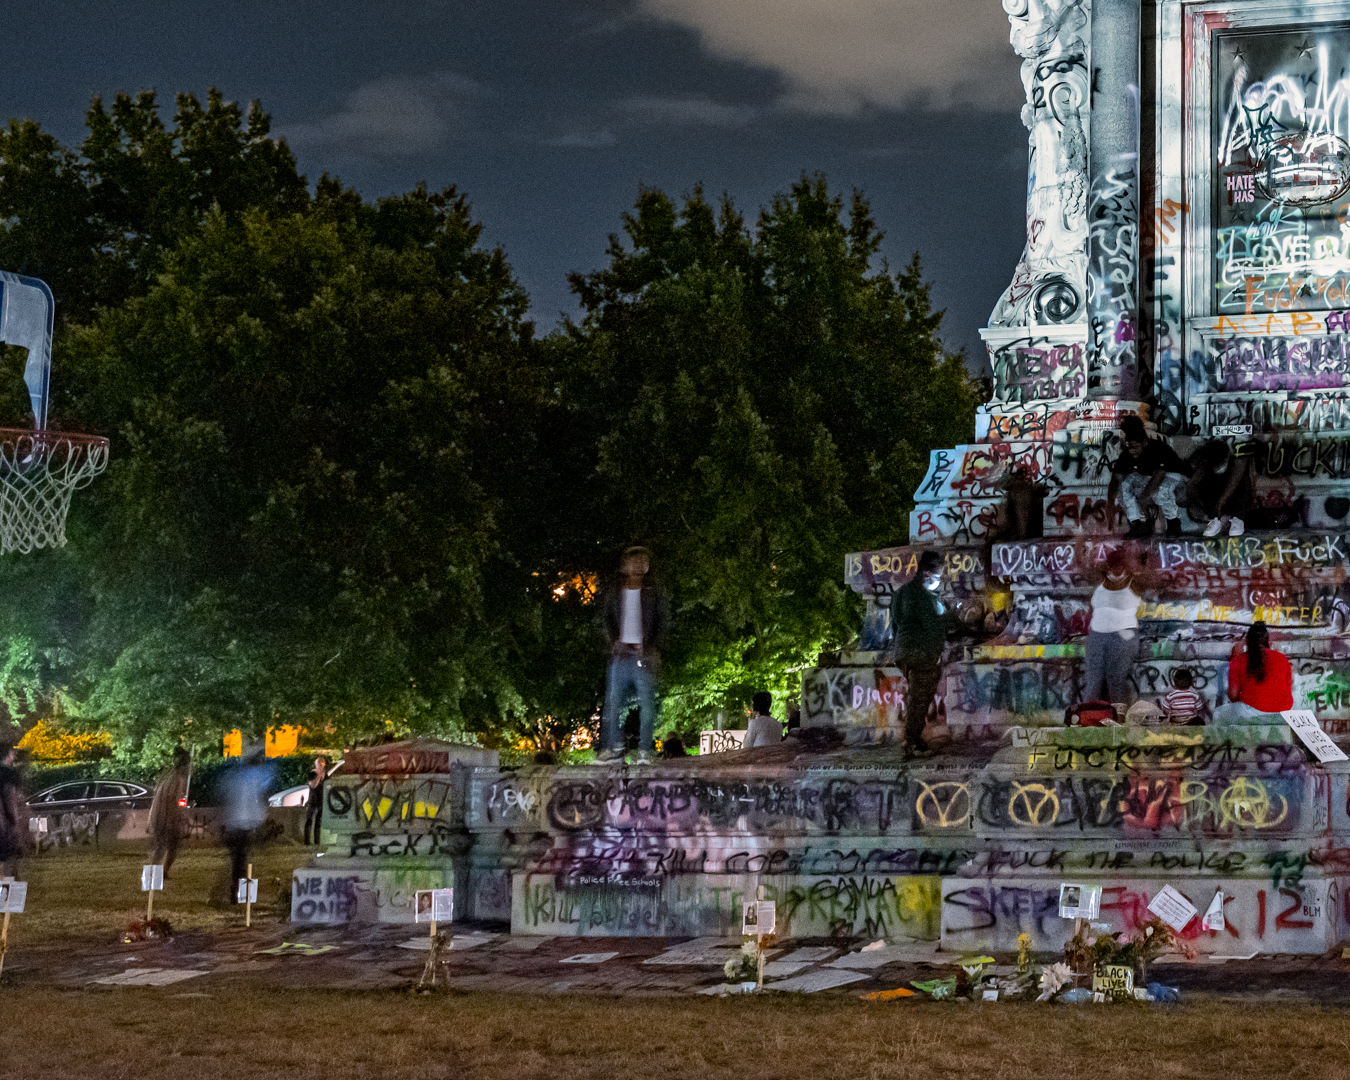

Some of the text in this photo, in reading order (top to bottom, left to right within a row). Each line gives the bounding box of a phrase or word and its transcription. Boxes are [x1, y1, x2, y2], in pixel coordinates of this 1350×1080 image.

[1226, 174, 1255, 191] HATE
[1234, 190, 1255, 203] HAS
[1213, 311, 1322, 336] ACAB
[871, 554, 903, 573] $20
[906, 553, 919, 572] A
[1022, 550, 1054, 571] blm
[1138, 601, 1191, 621] LACK
[852, 684, 905, 711] Black
[1088, 850, 1136, 871] THE
[1151, 850, 1247, 872] POLICE
[296, 876, 322, 897] WE
[579, 875, 605, 887] Police
[1099, 885, 1239, 938] FUK
[1257, 885, 1314, 938] 12
[1303, 905, 1321, 917] BLM
